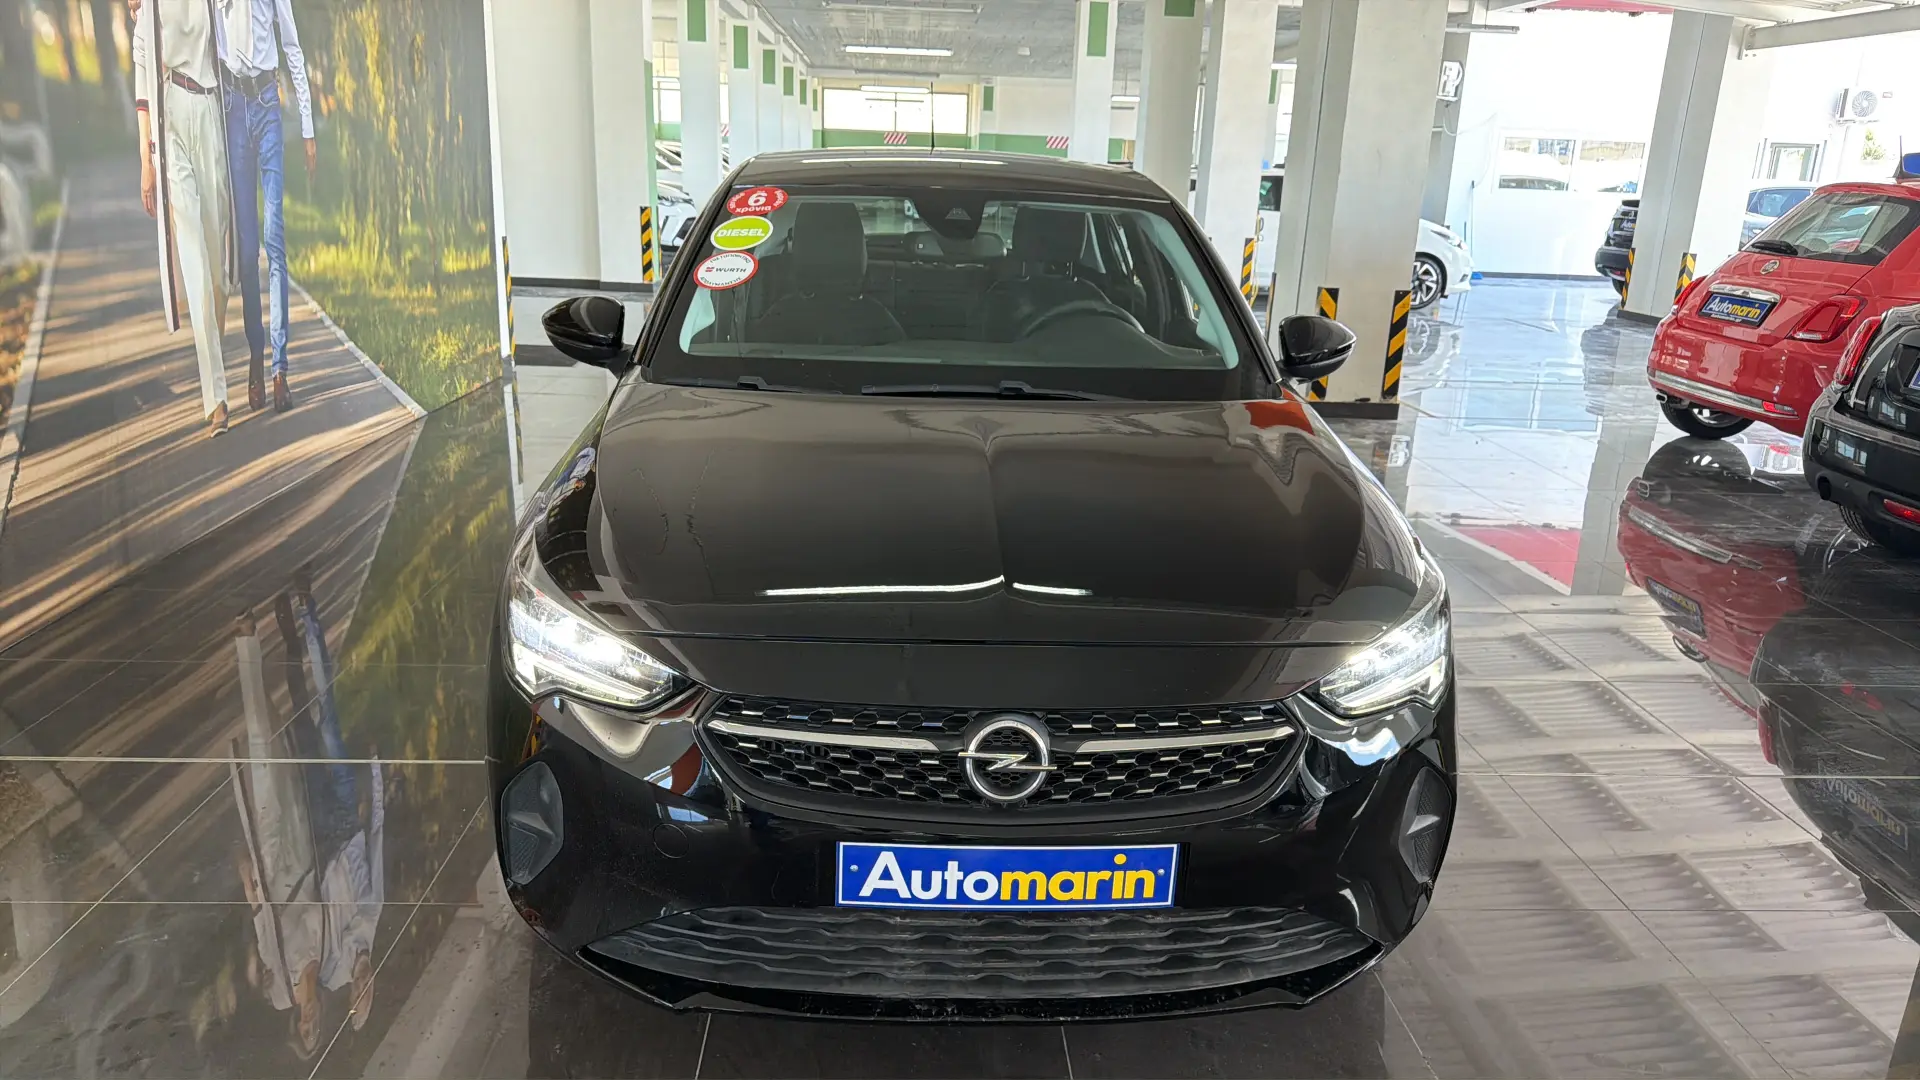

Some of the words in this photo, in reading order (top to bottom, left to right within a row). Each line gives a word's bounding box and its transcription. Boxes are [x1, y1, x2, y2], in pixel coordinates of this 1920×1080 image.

[747, 192, 768, 206] 6
[716, 228, 765, 238] DIESEL
[1707, 297, 1760, 318] Automarin
[858, 851, 1156, 901] Automarin
